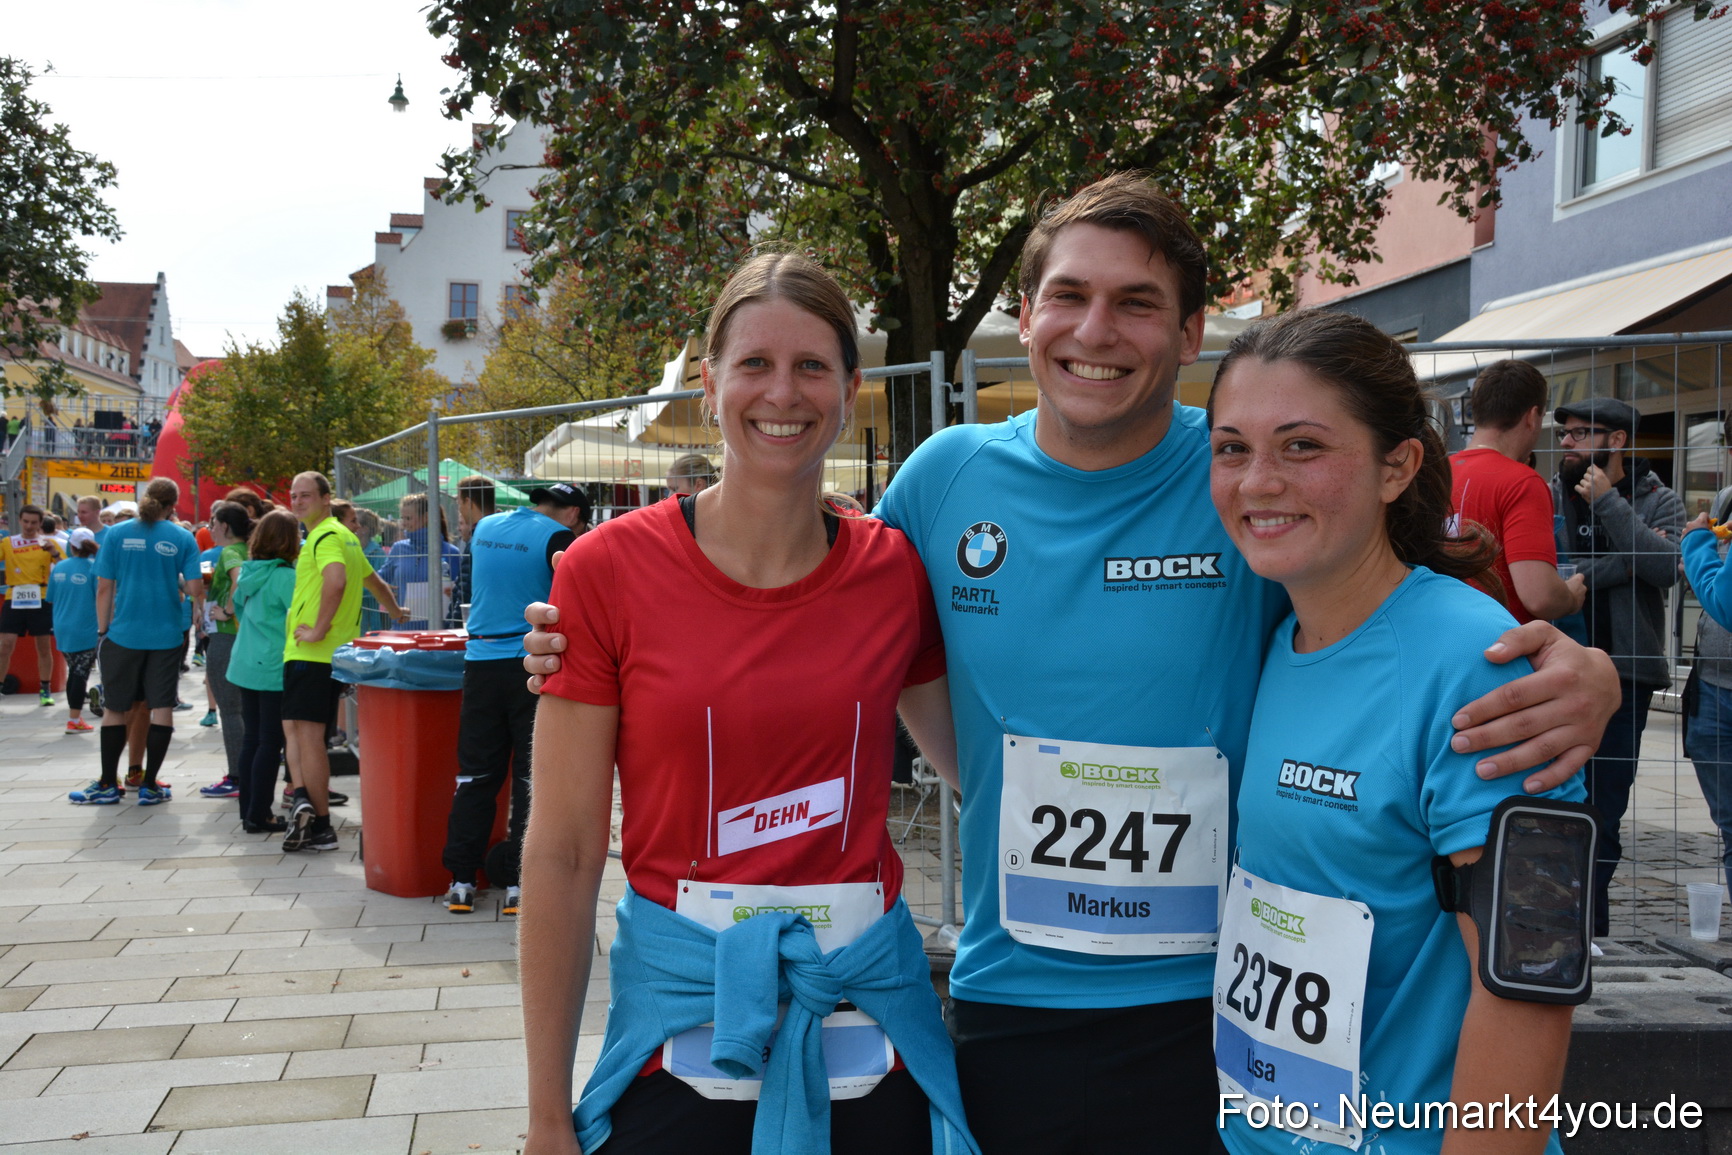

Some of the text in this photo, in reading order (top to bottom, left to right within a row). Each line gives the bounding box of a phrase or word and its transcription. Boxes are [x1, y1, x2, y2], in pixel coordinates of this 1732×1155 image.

[109, 465, 145, 478] ZIEL
[965, 523, 1005, 544] BMW
[494, 541, 513, 550] your
[514, 543, 529, 552] life
[1105, 554, 1224, 581] BOCK
[16, 591, 37, 600] 2616
[952, 585, 1000, 604] PARTL
[1103, 580, 1227, 593] inspired by smart concepts
[951, 601, 999, 616] Neumarkt
[1082, 763, 1160, 783] BOCK
[1279, 760, 1360, 800] BOCK
[1082, 780, 1106, 788] inspired
[1276, 787, 1359, 813] inspired by smart concepts
[754, 800, 810, 833] DEHN
[1031, 804, 1192, 873] 2247
[1067, 892, 1151, 918] Markus
[1261, 901, 1305, 936] BOCK
[1226, 942, 1331, 1045] 2378
